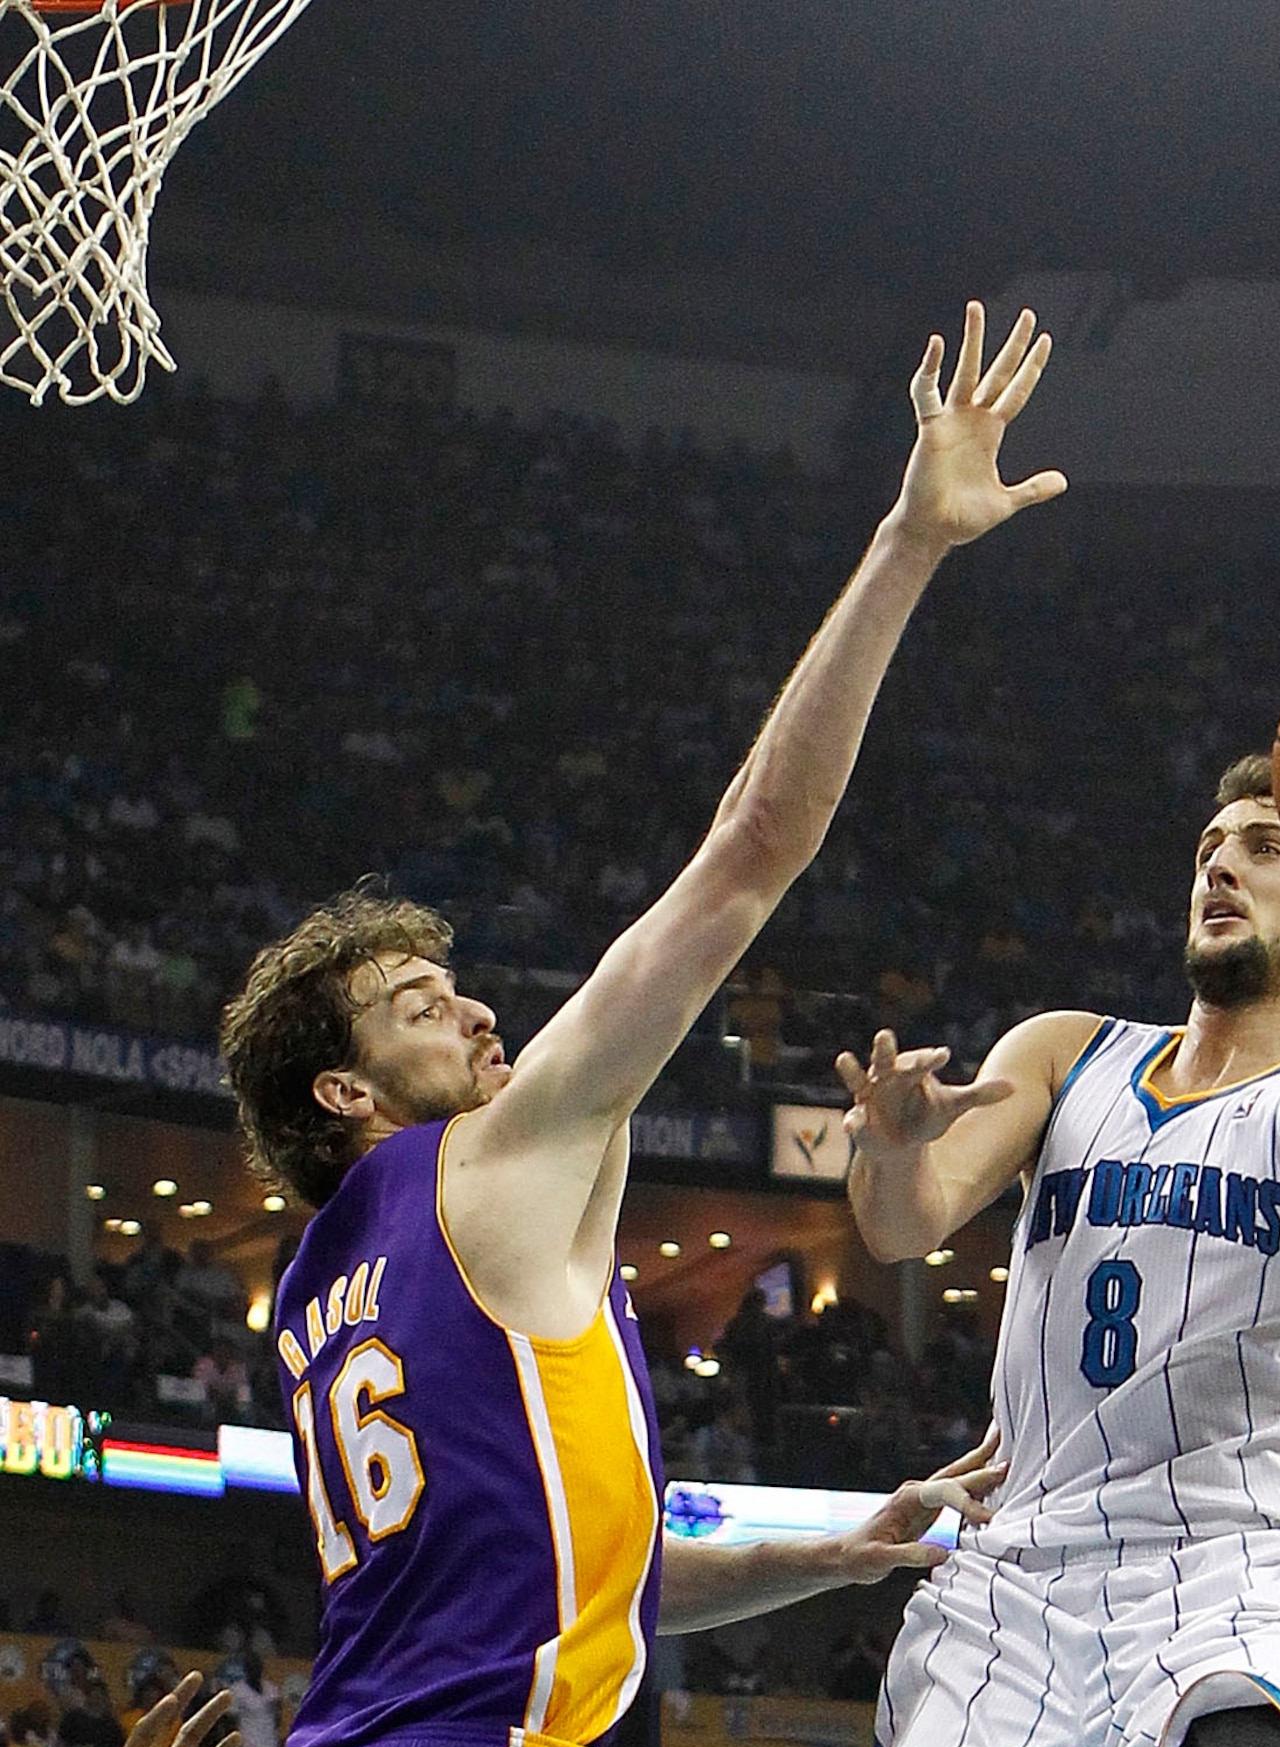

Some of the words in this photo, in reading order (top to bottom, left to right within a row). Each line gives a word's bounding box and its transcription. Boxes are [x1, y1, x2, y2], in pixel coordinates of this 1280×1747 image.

[277, 1256, 388, 1380] GASOL
[1080, 1260, 1143, 1388] 8
[293, 1336, 425, 1585] 16
